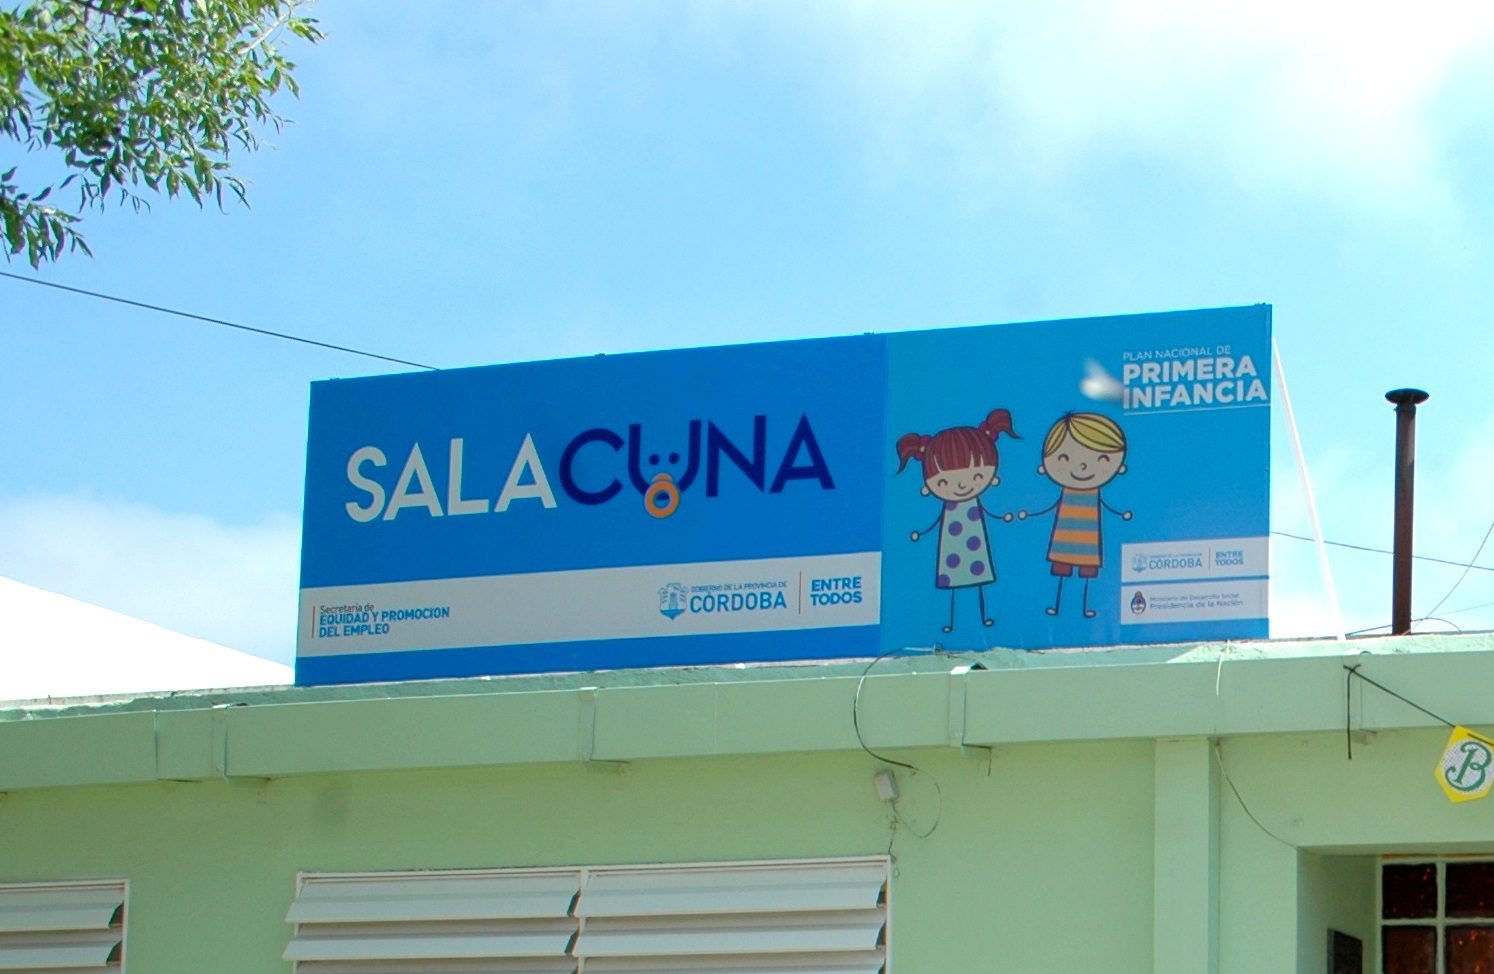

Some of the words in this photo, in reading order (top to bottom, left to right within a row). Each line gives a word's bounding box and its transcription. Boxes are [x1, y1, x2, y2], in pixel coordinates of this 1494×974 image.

[1123, 351, 1152, 361] PLAN
[1155, 347, 1212, 359] NACIONAL
[1216, 345, 1231, 355] DE
[1123, 355, 1257, 385] PRIMERA
[1123, 379, 1268, 409] INFANCIA
[1216, 550, 1243, 558] ENTRE
[1216, 557, 1243, 566] TODOS
[811, 576, 862, 592] ENTRE
[690, 591, 787, 613] CÓRDOBA
[810, 591, 863, 606] TODOS
[364, 603, 374, 612] de
[320, 612, 369, 625] EQUIDAD
[372, 612, 379, 622] Y
[319, 627, 340, 638] DEL
[343, 623, 390, 636] EMPLEO
